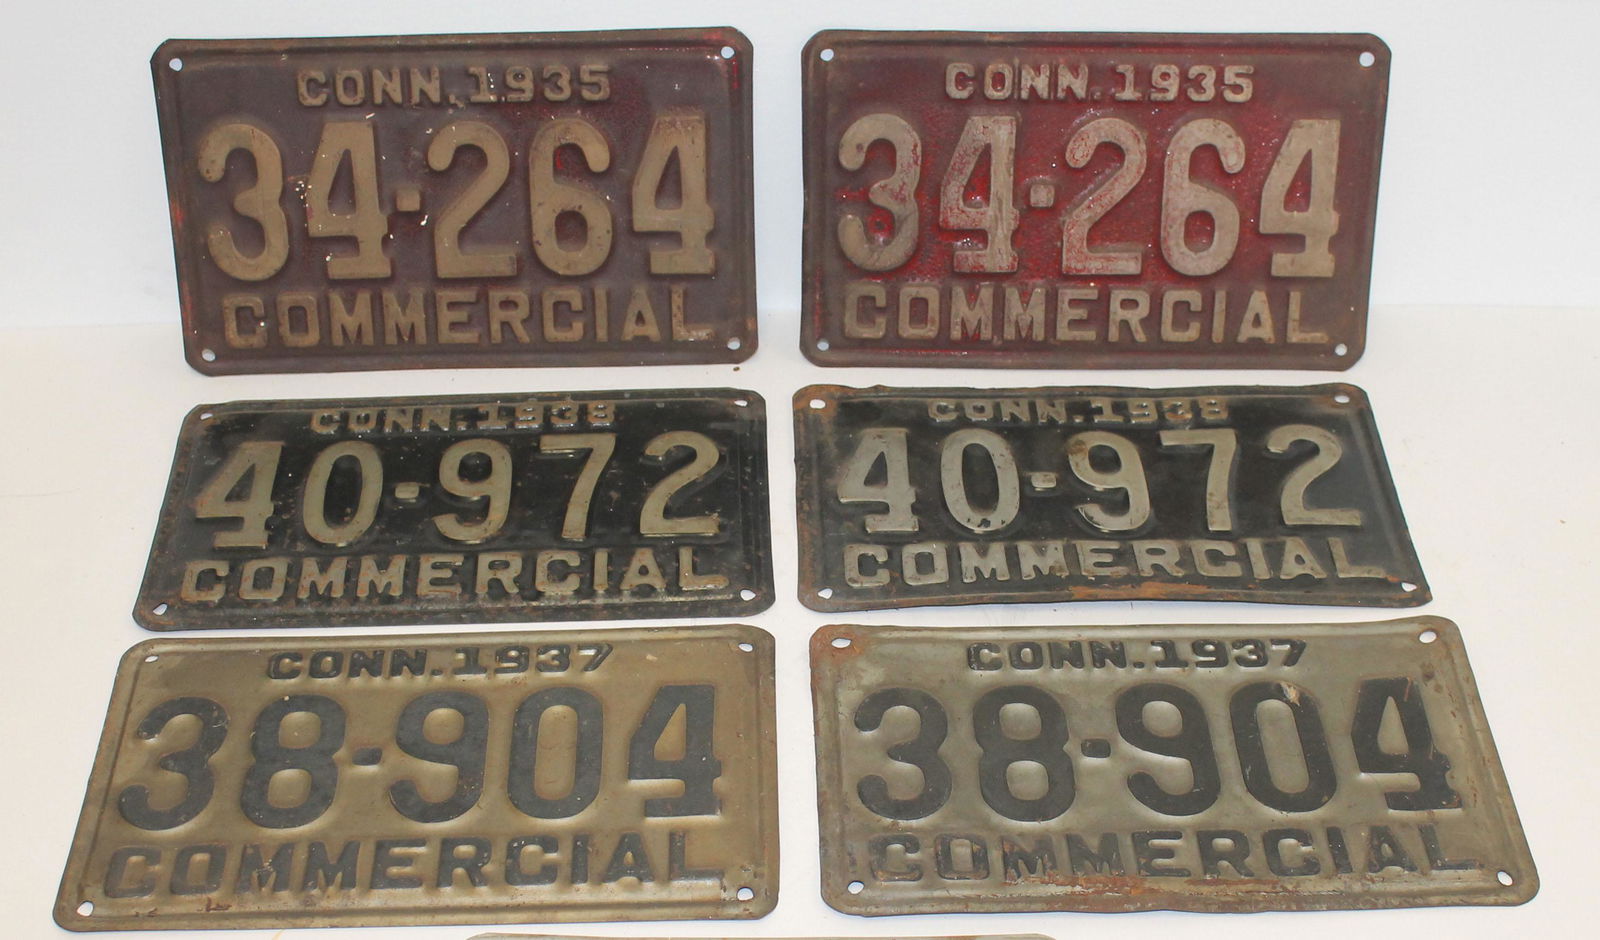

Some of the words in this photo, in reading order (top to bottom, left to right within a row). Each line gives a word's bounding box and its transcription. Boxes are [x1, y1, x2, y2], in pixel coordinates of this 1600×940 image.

[199, 112, 716, 281] 34-264
[837, 113, 1342, 279] 34-264
[222, 285, 714, 349] COMMERCIAL
[843, 284, 1331, 344] COMMERCIAL
[195, 430, 721, 551] 40-972
[838, 425, 1363, 535] 40-972
[180, 547, 731, 602] COMMERCIAL
[842, 538, 1387, 588] COMMERCIAL
[117, 684, 723, 832] 38-904
[853, 676, 1463, 823] 38-904
[103, 831, 726, 899] COMMERCIAL
[867, 823, 1483, 883] COMMERCIAL
